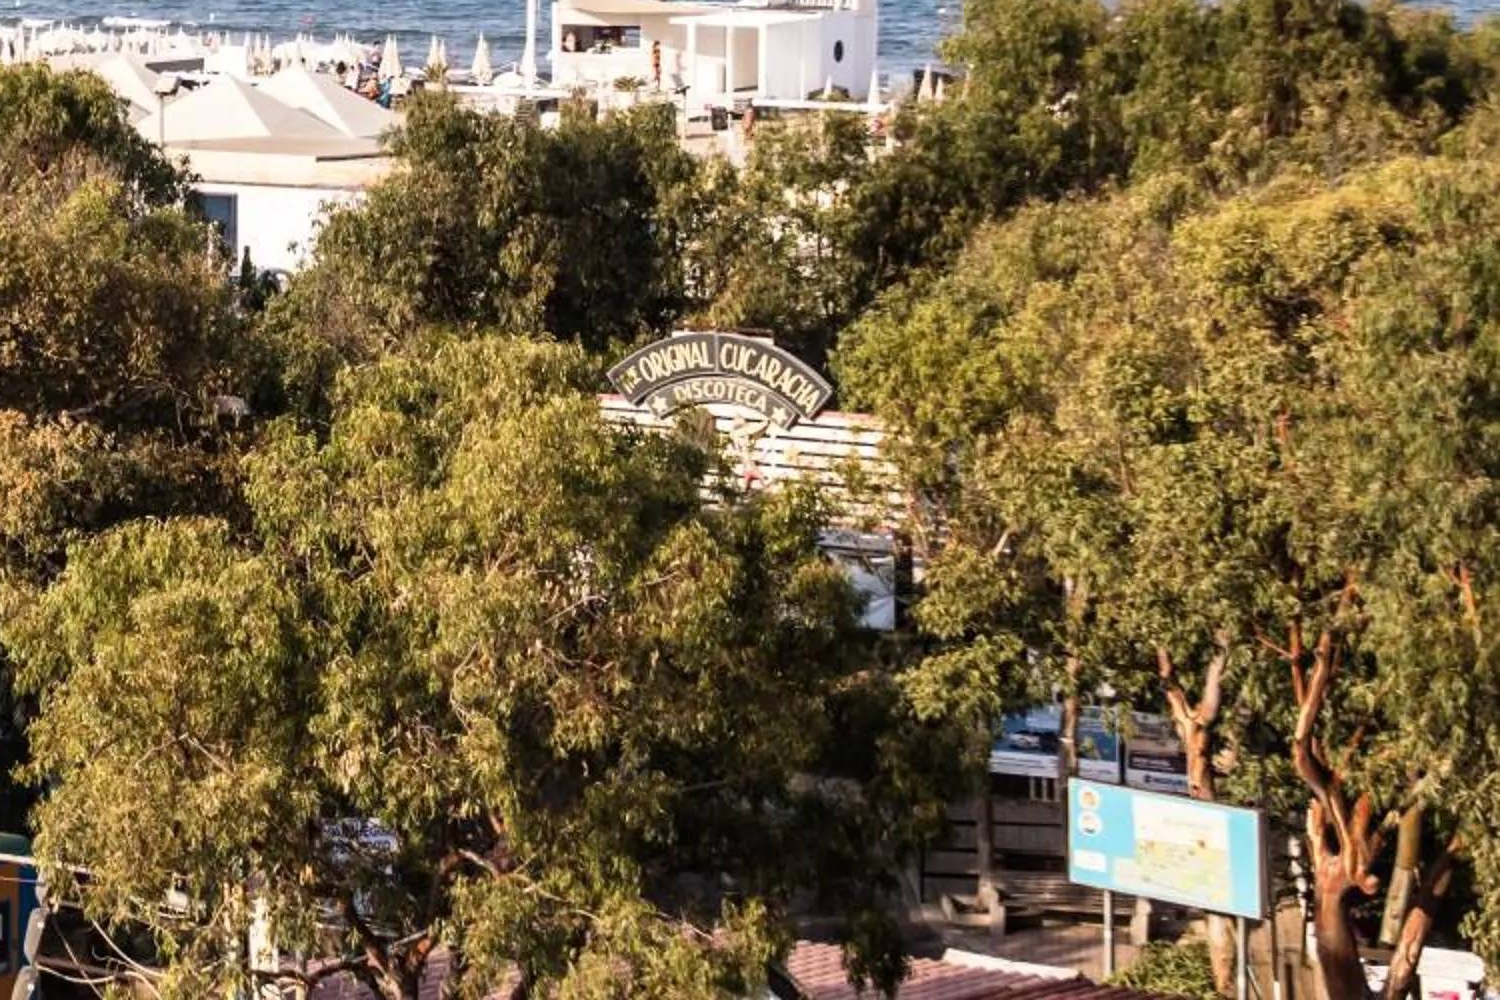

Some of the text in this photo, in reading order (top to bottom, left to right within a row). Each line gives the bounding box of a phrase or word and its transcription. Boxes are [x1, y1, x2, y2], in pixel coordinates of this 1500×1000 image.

[639, 341, 715, 382] ORIGINAL
[721, 343, 821, 413] CUCARACHA
[673, 381, 767, 412] DISCOTECA
